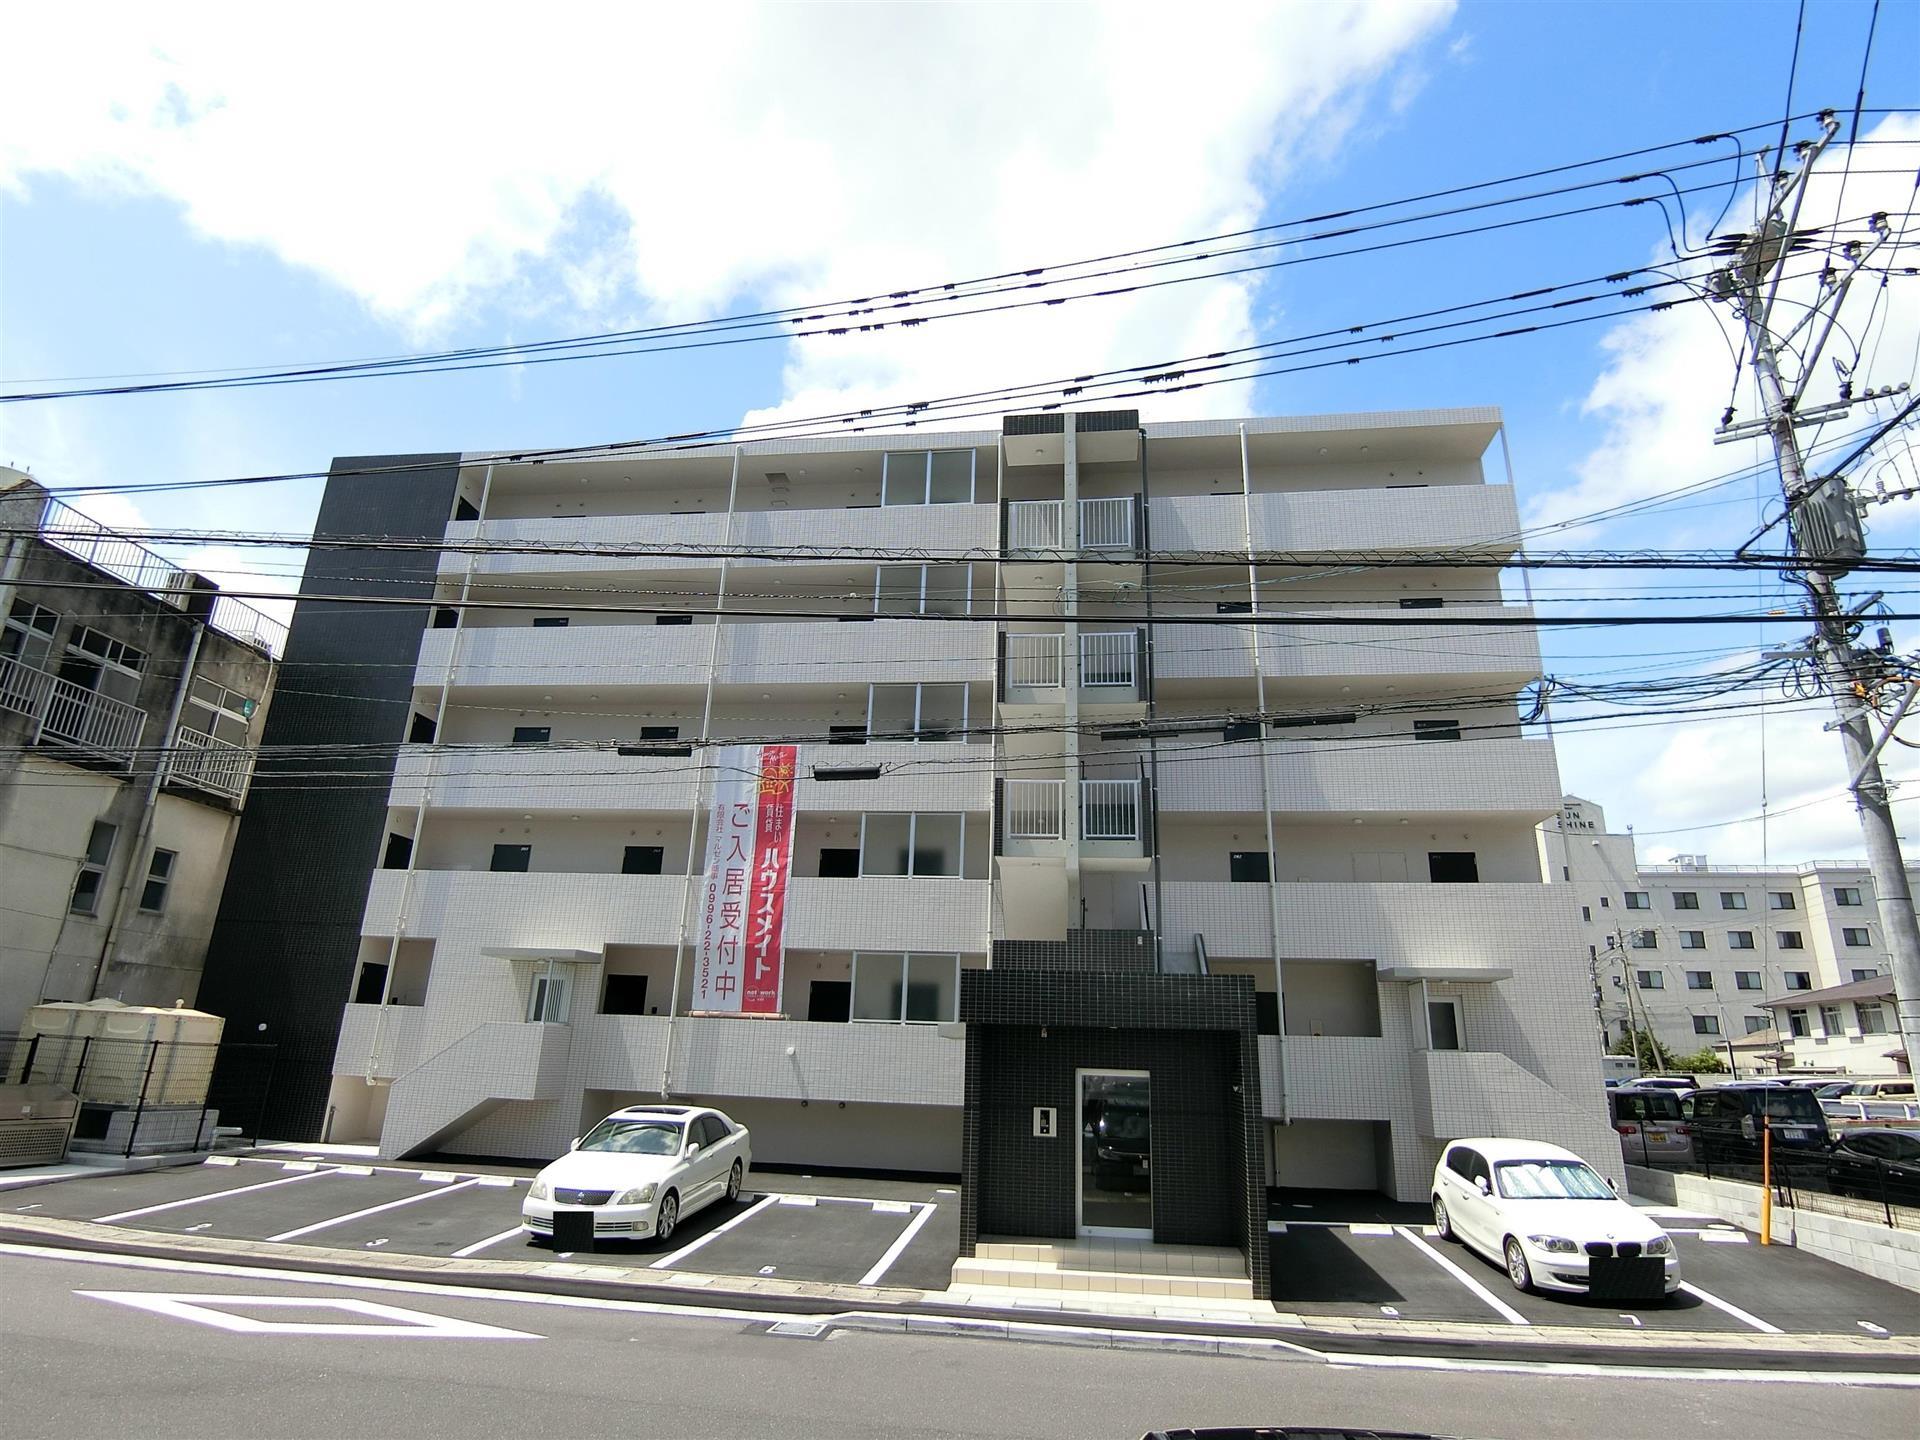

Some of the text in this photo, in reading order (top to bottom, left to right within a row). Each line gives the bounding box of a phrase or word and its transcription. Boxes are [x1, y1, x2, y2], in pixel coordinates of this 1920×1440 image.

[774, 804, 784, 843] 住まい
[1557, 820, 1594, 828] SHINE
[701, 883, 716, 999] 0996-22-3521
[715, 804, 751, 1000] ご入居受付中
[755, 848, 779, 979] ハウスメイト
